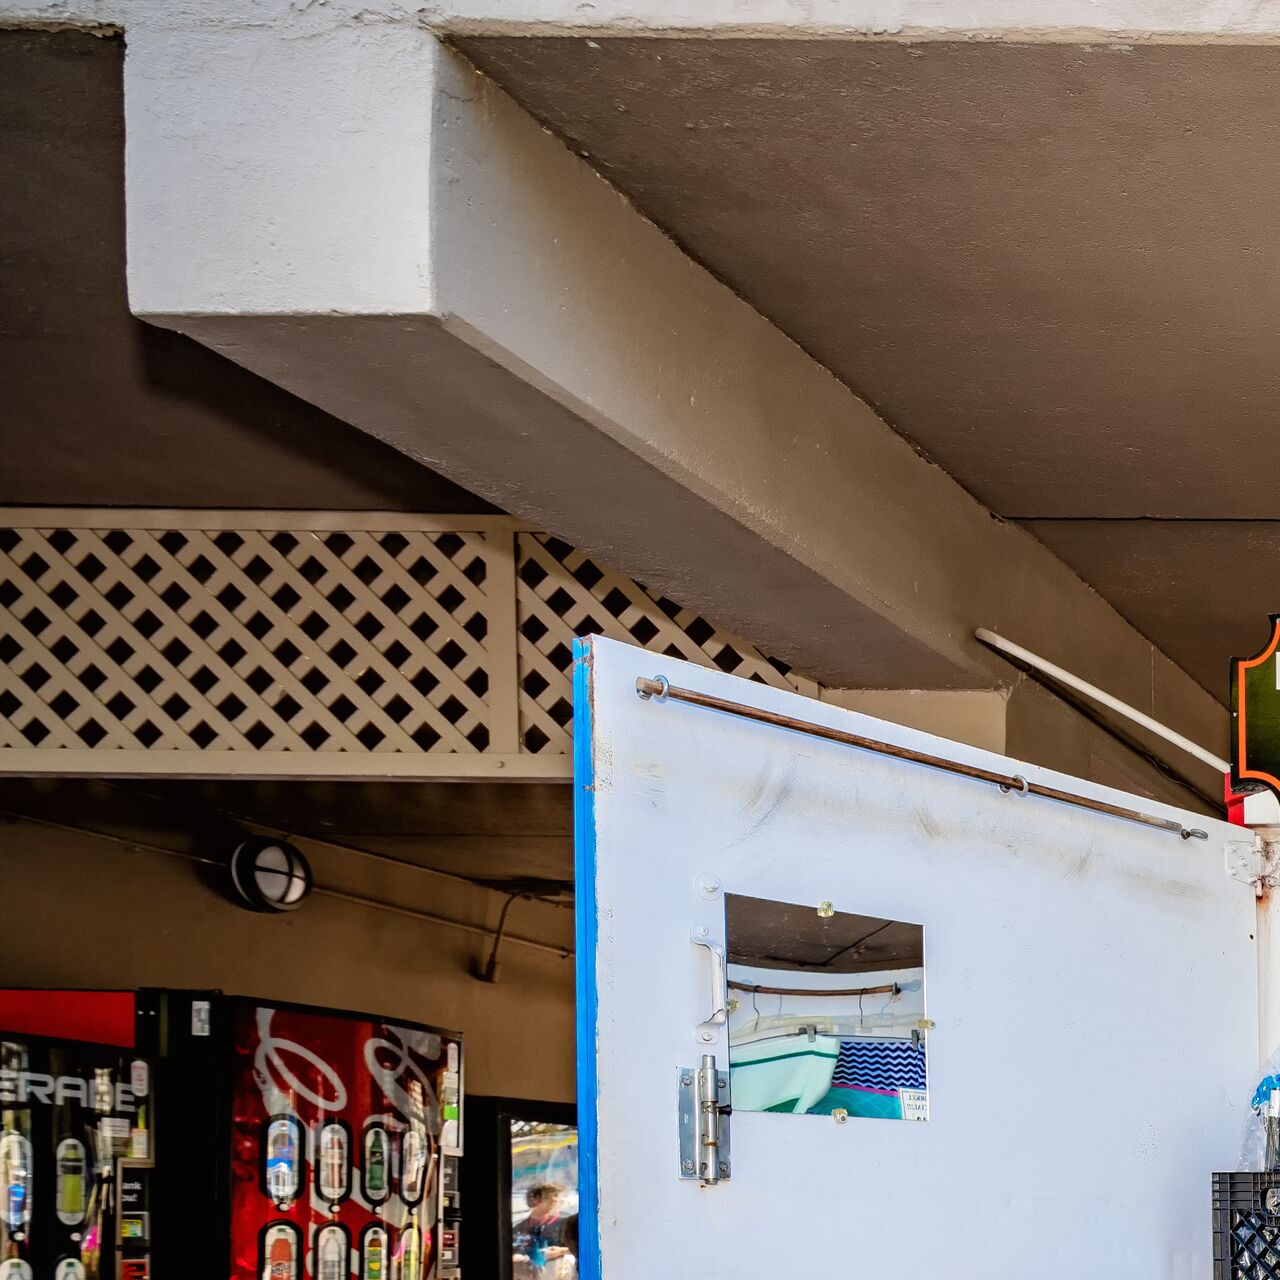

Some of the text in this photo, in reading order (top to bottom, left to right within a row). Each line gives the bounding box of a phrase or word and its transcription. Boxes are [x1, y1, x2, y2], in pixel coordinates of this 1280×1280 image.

[0, 1068, 135, 1112] ERADE
[122, 1182, 142, 1190] ank
[121, 1194, 138, 1202] ou!
